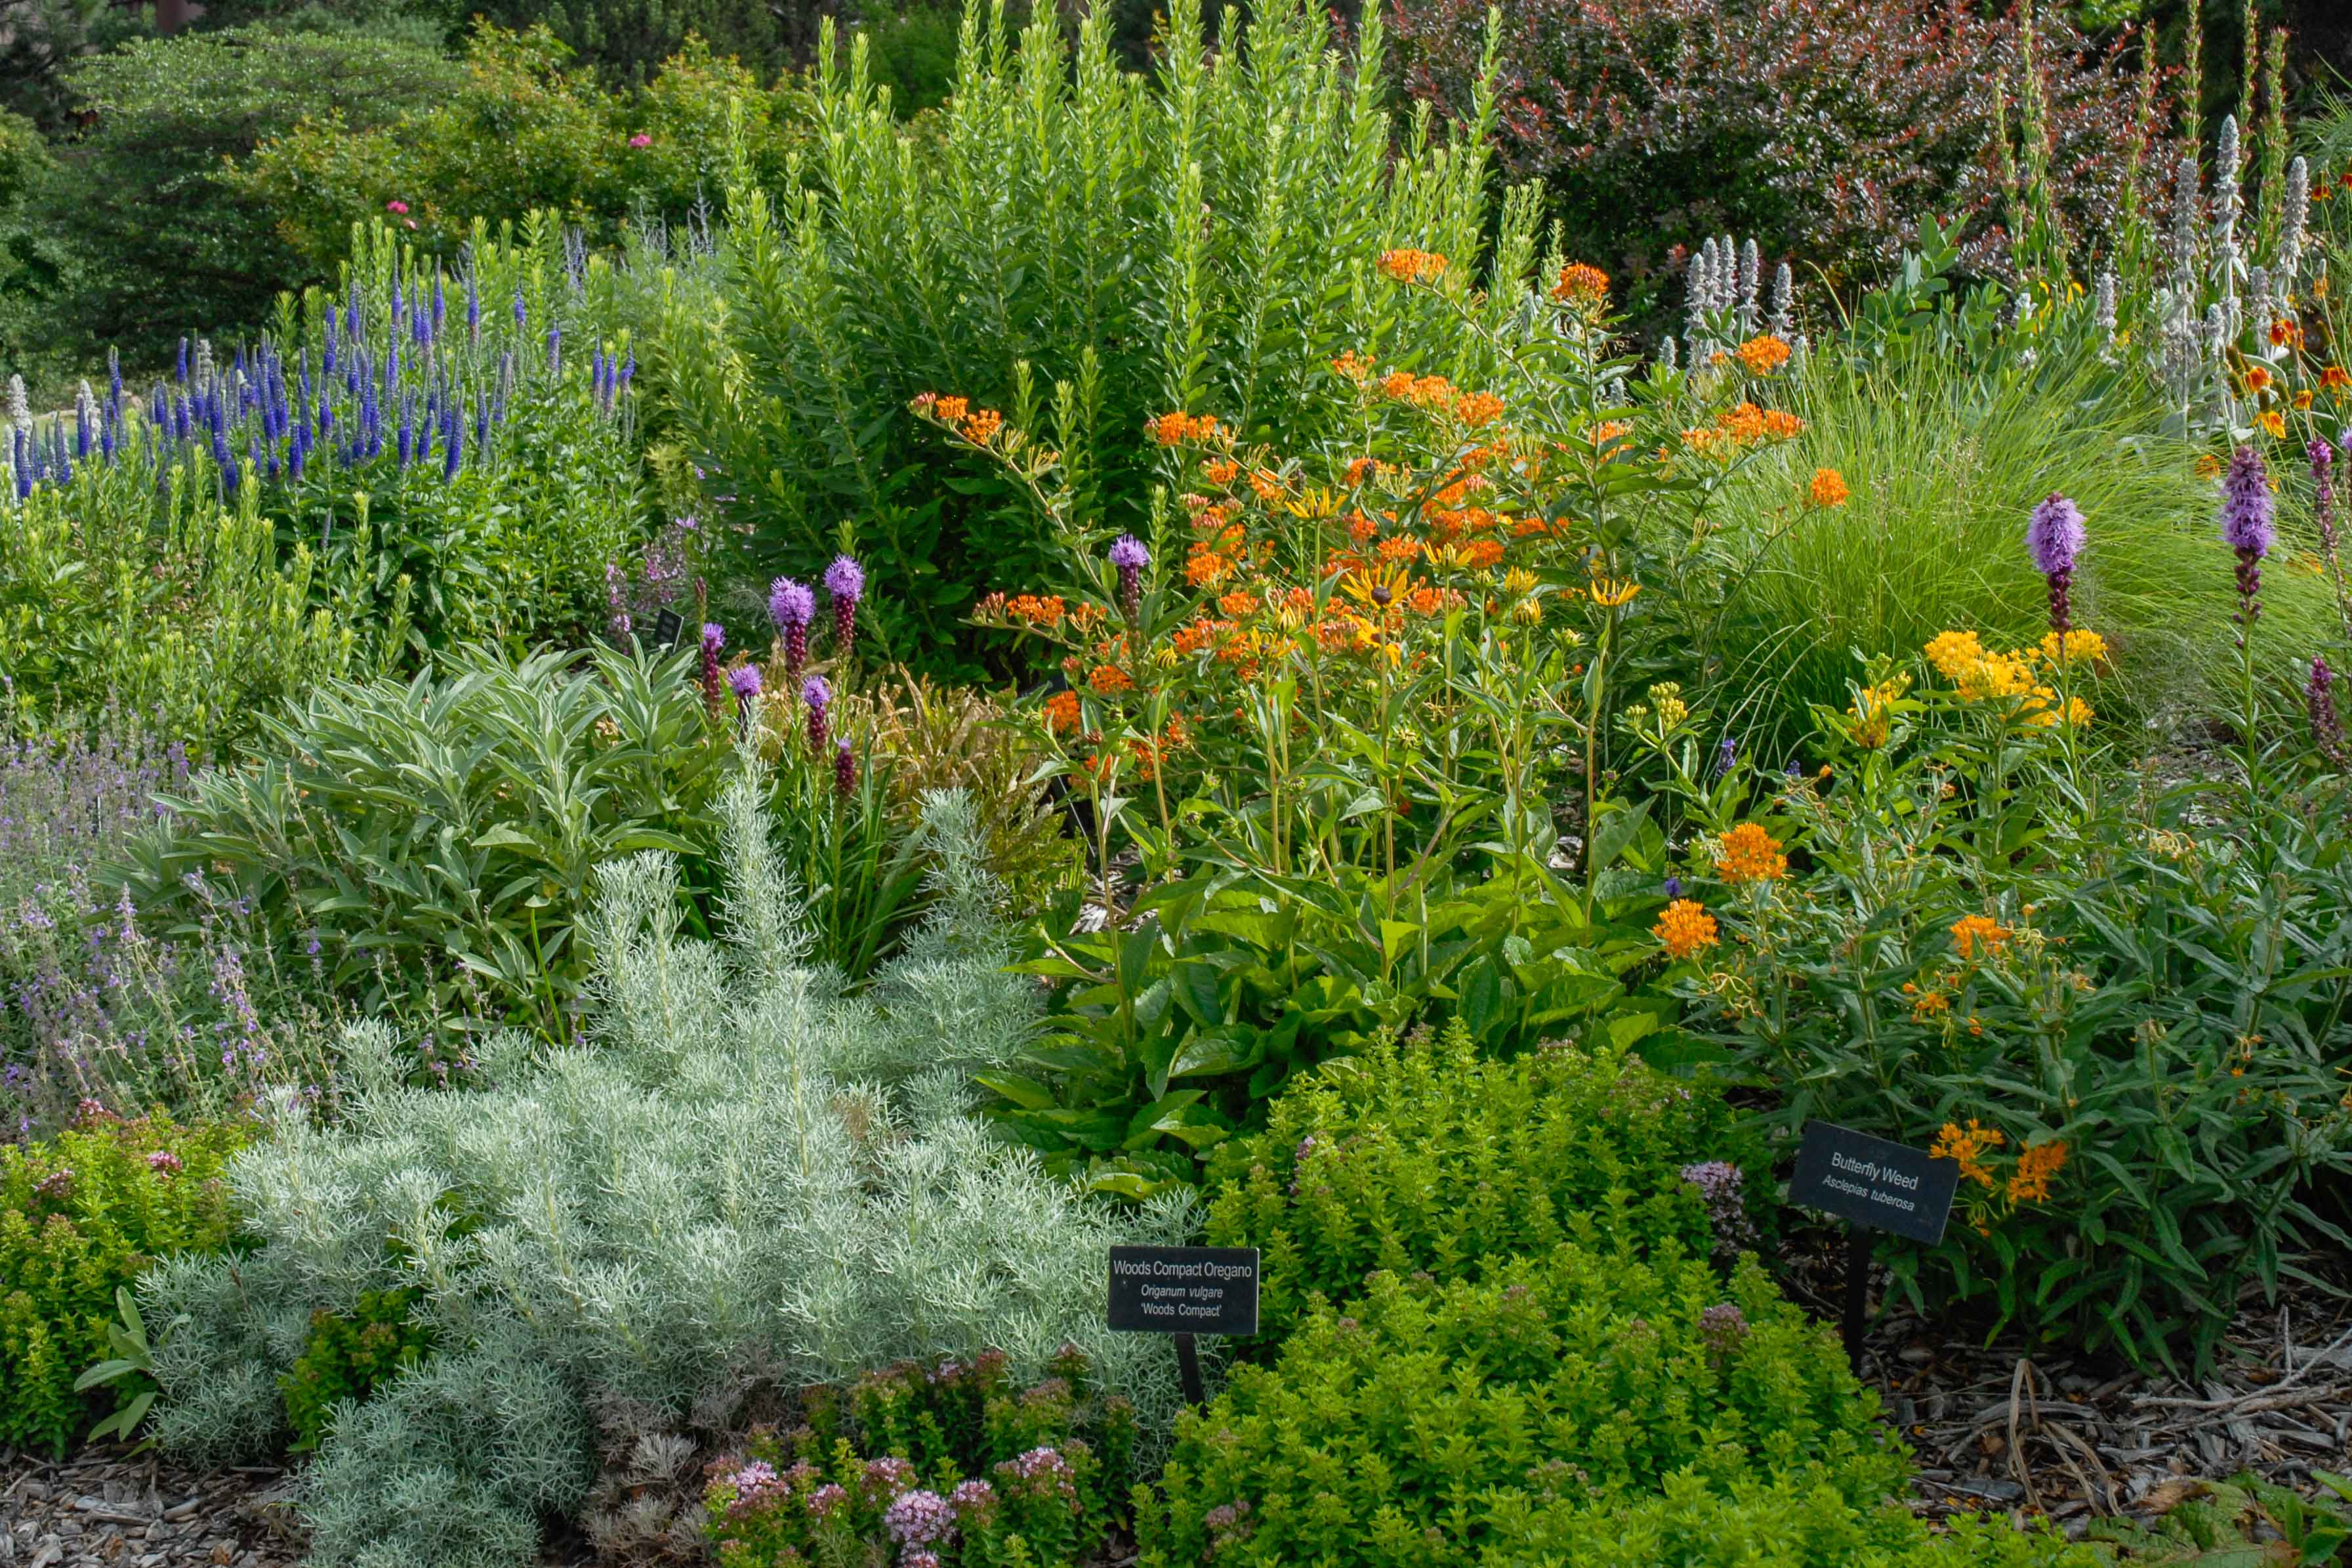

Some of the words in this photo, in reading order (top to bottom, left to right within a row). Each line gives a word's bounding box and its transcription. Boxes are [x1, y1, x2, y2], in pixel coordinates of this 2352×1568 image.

[1832, 1152, 1880, 1181] Butterfly
[1882, 1166, 1919, 1191] Weed
[1823, 1174, 1868, 1197] Asclepias
[1870, 1189, 1915, 1212] tuberosa
[1113, 1260, 1151, 1275] Woods
[1153, 1261, 1202, 1279] Compact
[1205, 1262, 1252, 1280] Oregano
[1141, 1284, 1186, 1299] Origanum
[1189, 1286, 1223, 1300] vulgare
